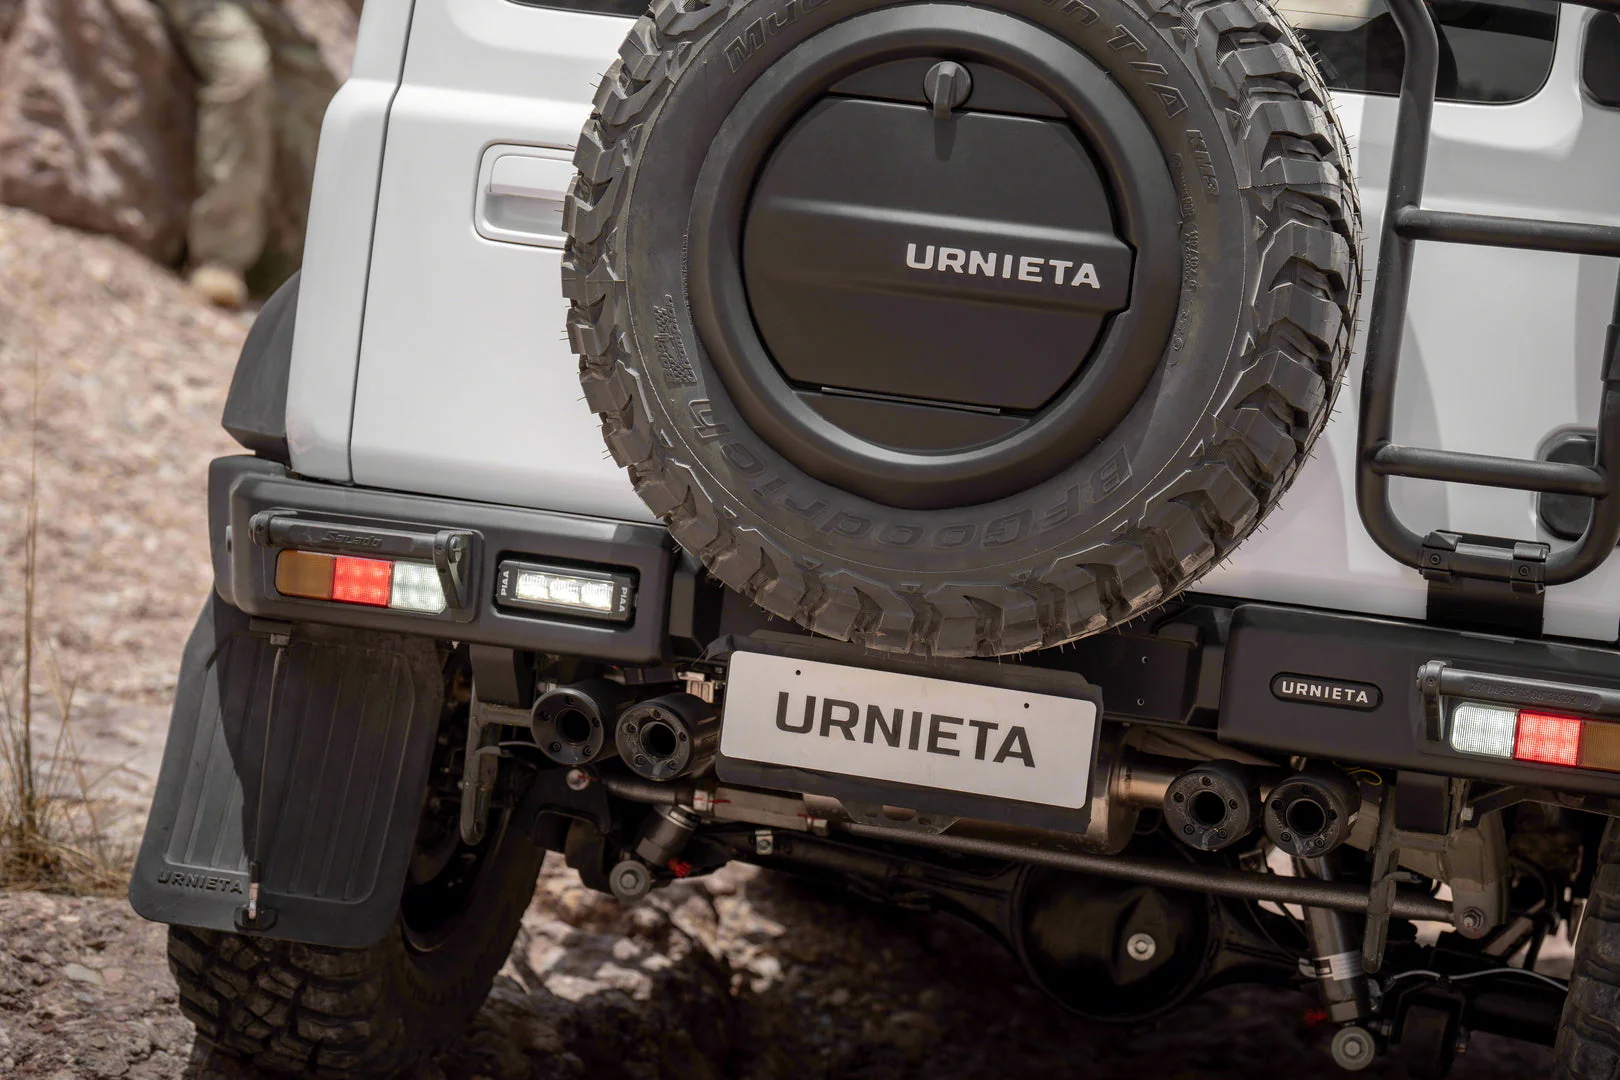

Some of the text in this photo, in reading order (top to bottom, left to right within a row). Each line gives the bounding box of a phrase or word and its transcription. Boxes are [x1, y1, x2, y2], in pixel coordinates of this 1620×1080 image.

[906, 243, 1101, 289] URNIETA
[688, 398, 1133, 549] BFGoodrich
[500, 570, 510, 596] PIAA
[619, 586, 628, 612] PIAA
[1282, 681, 1368, 704] URNIETA
[775, 691, 1036, 768] URNIETA
[157, 871, 243, 895] URNIETA
